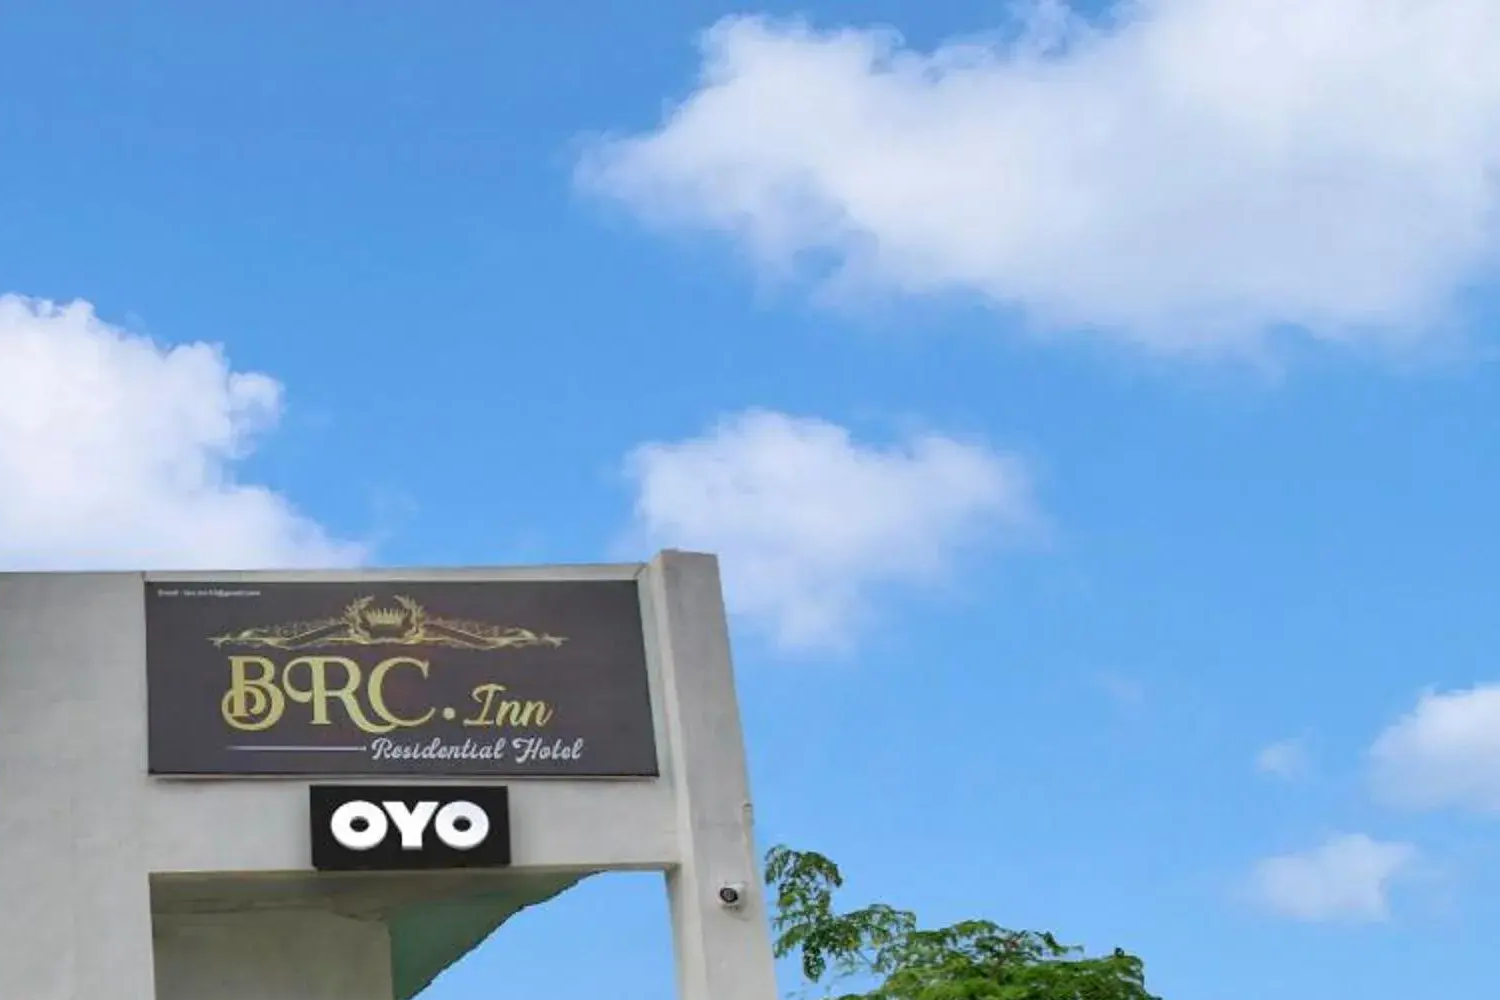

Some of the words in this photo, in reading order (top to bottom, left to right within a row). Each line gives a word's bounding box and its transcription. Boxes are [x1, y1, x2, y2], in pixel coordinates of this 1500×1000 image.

[463, 683, 554, 727] Inn
[371, 737, 505, 761] Residential
[511, 737, 585, 763] Hotel
[330, 799, 490, 851] OYO
